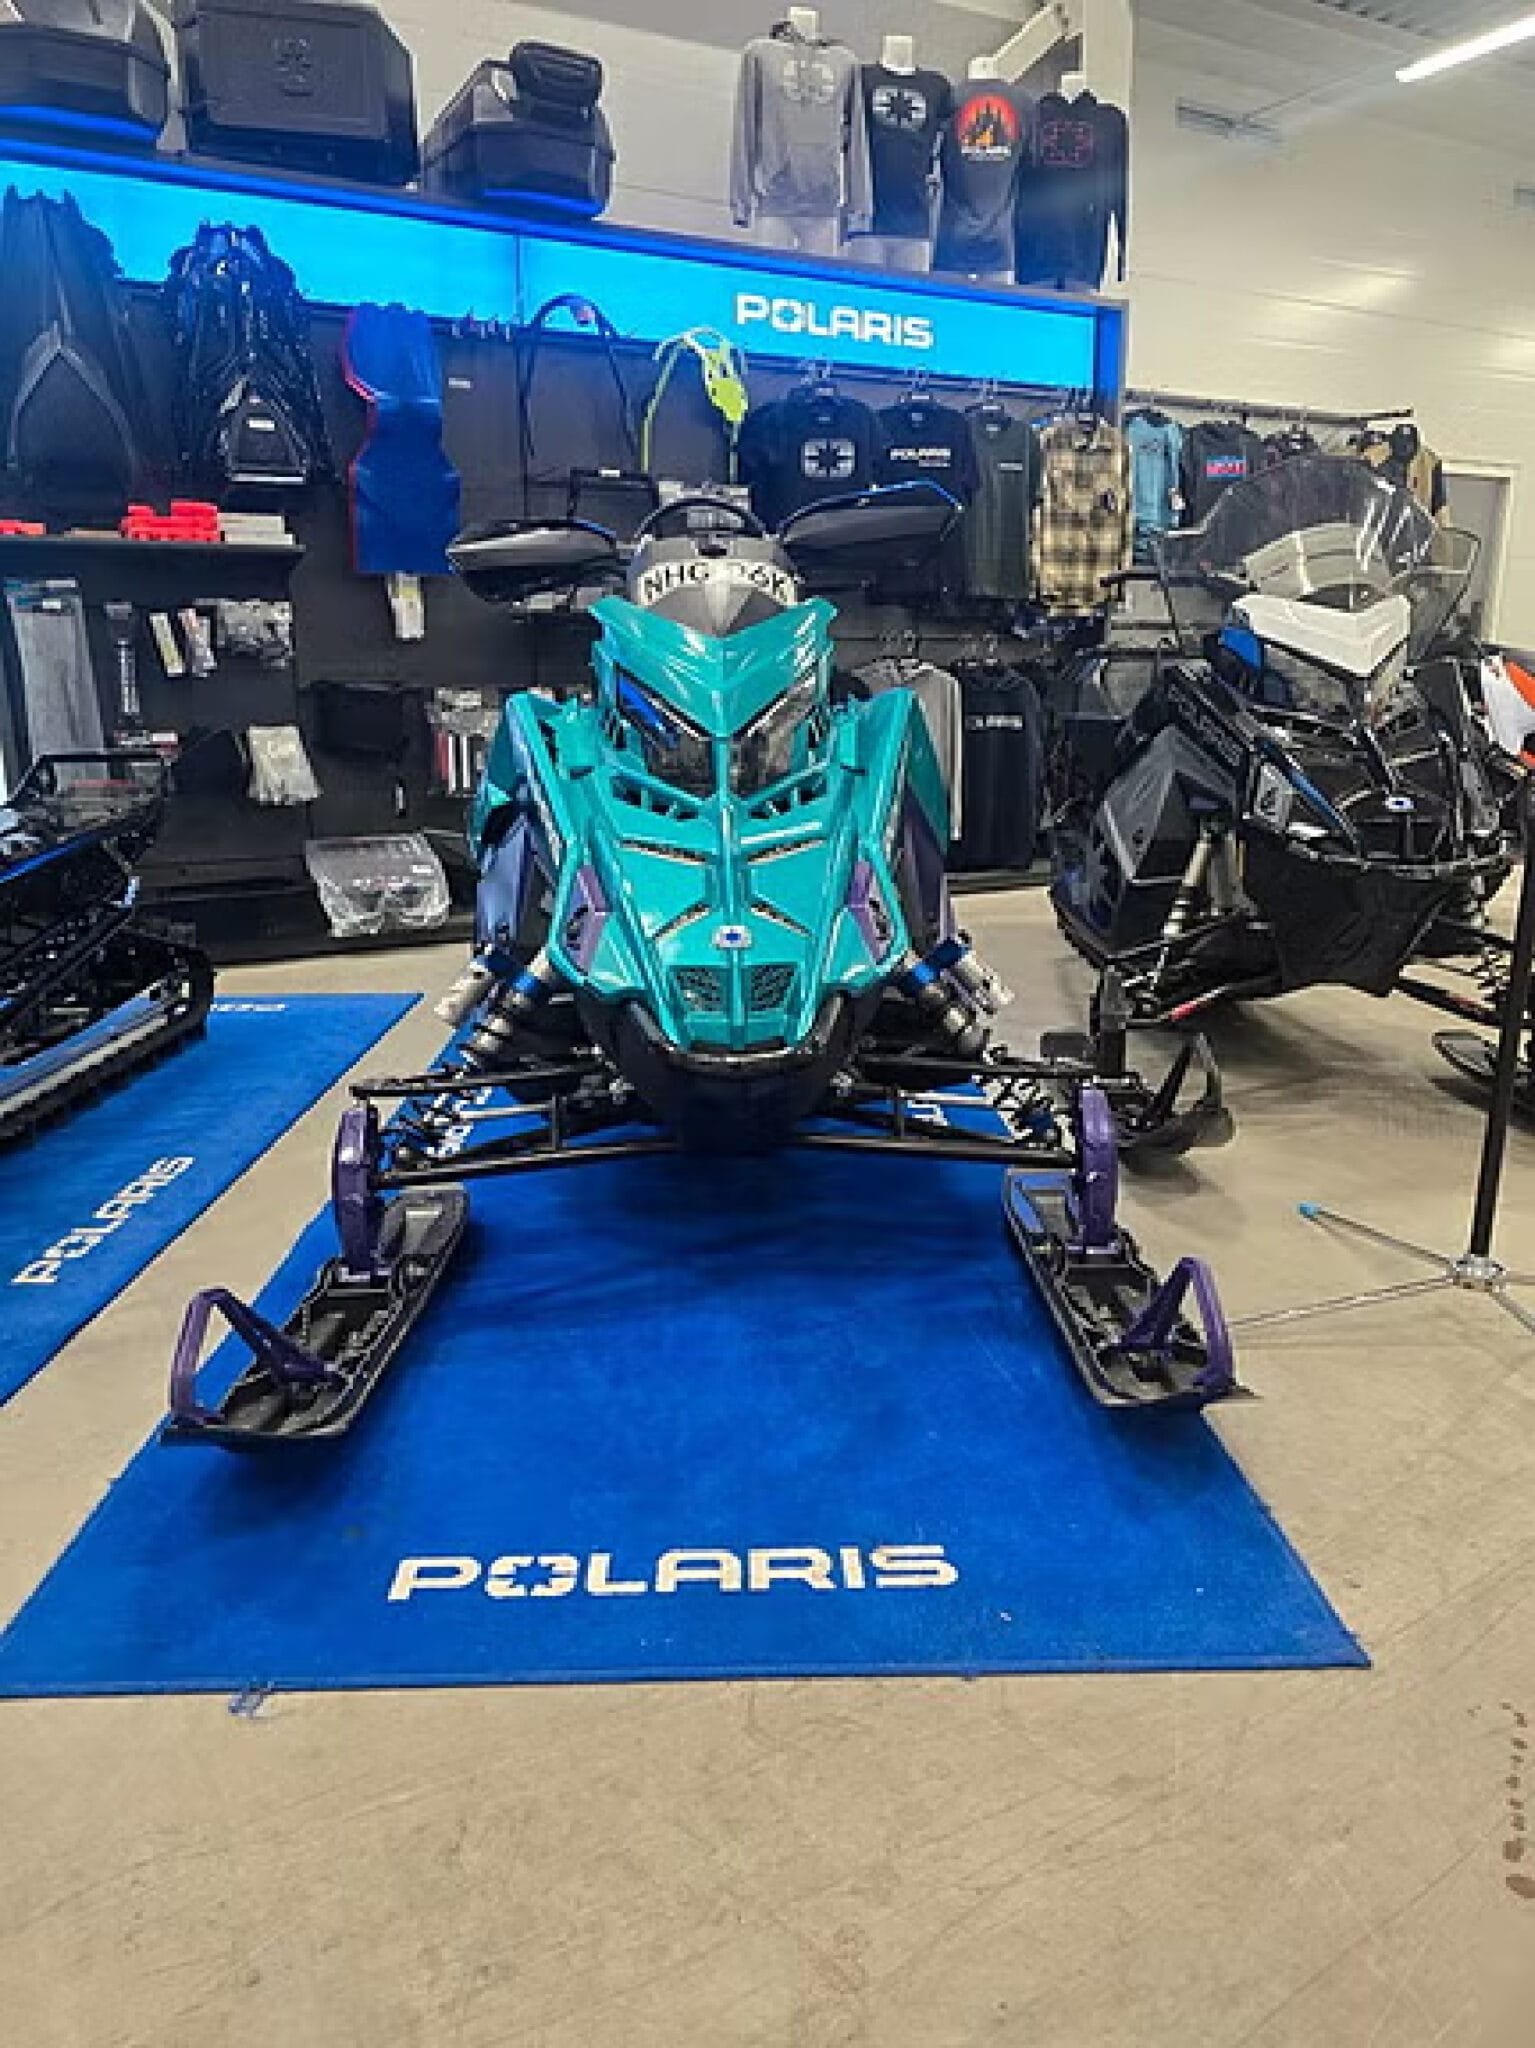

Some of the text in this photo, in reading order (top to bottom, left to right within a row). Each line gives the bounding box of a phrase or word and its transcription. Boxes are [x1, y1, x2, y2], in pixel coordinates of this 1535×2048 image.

[735, 292, 935, 350] POLARIS
[11, 1156, 196, 1285] POLARIS
[387, 1544, 960, 1602] POLARIS
